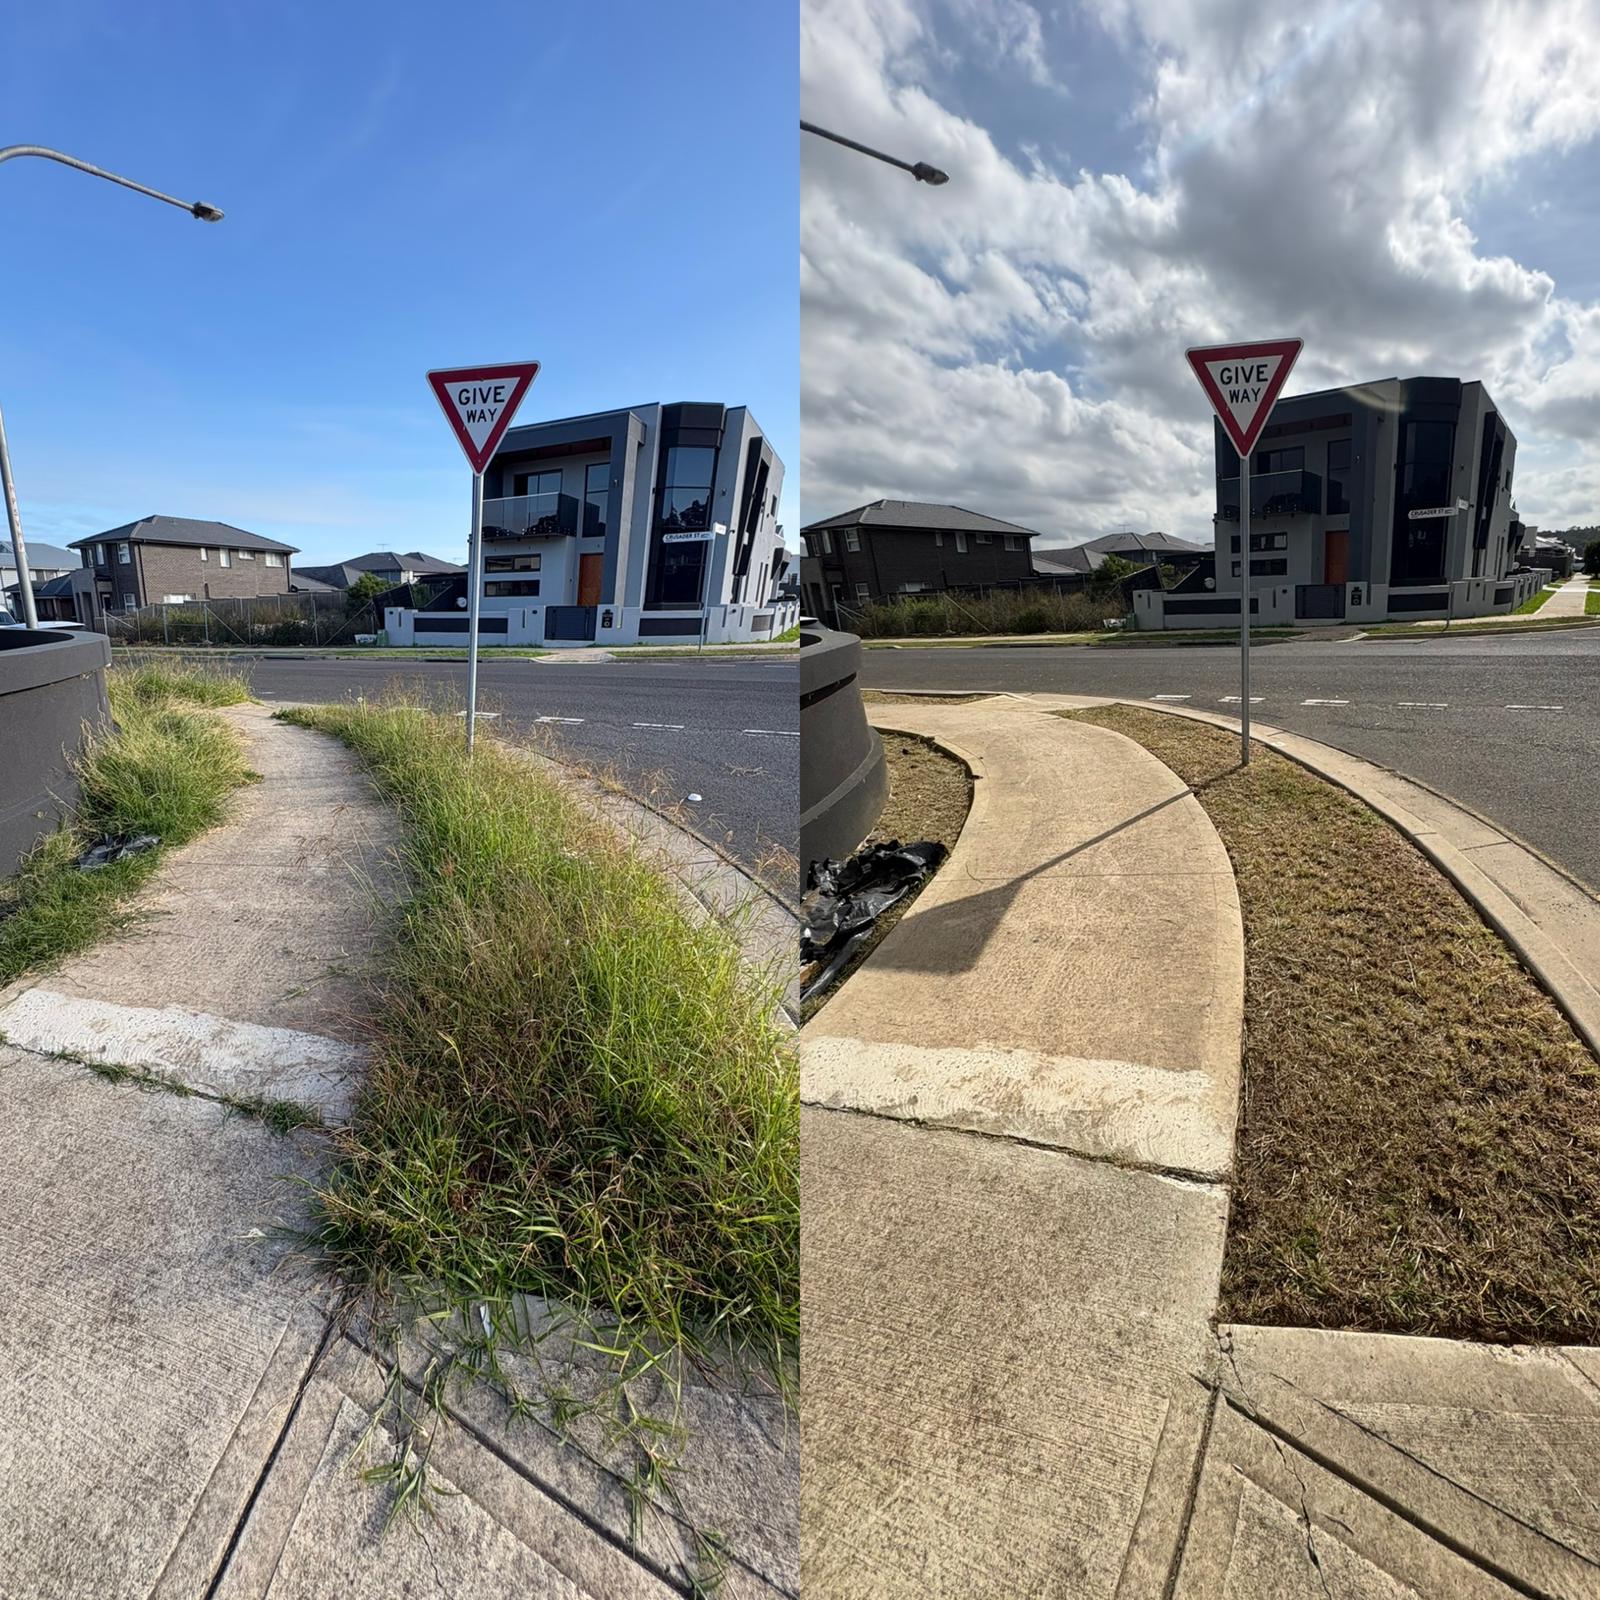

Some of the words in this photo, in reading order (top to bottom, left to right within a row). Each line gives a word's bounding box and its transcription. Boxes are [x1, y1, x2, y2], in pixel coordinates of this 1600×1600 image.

[1220, 364, 1268, 385] GIVE
[458, 385, 505, 406] GIVE
[1229, 388, 1261, 404] WAY
[466, 408, 498, 423] WAY
